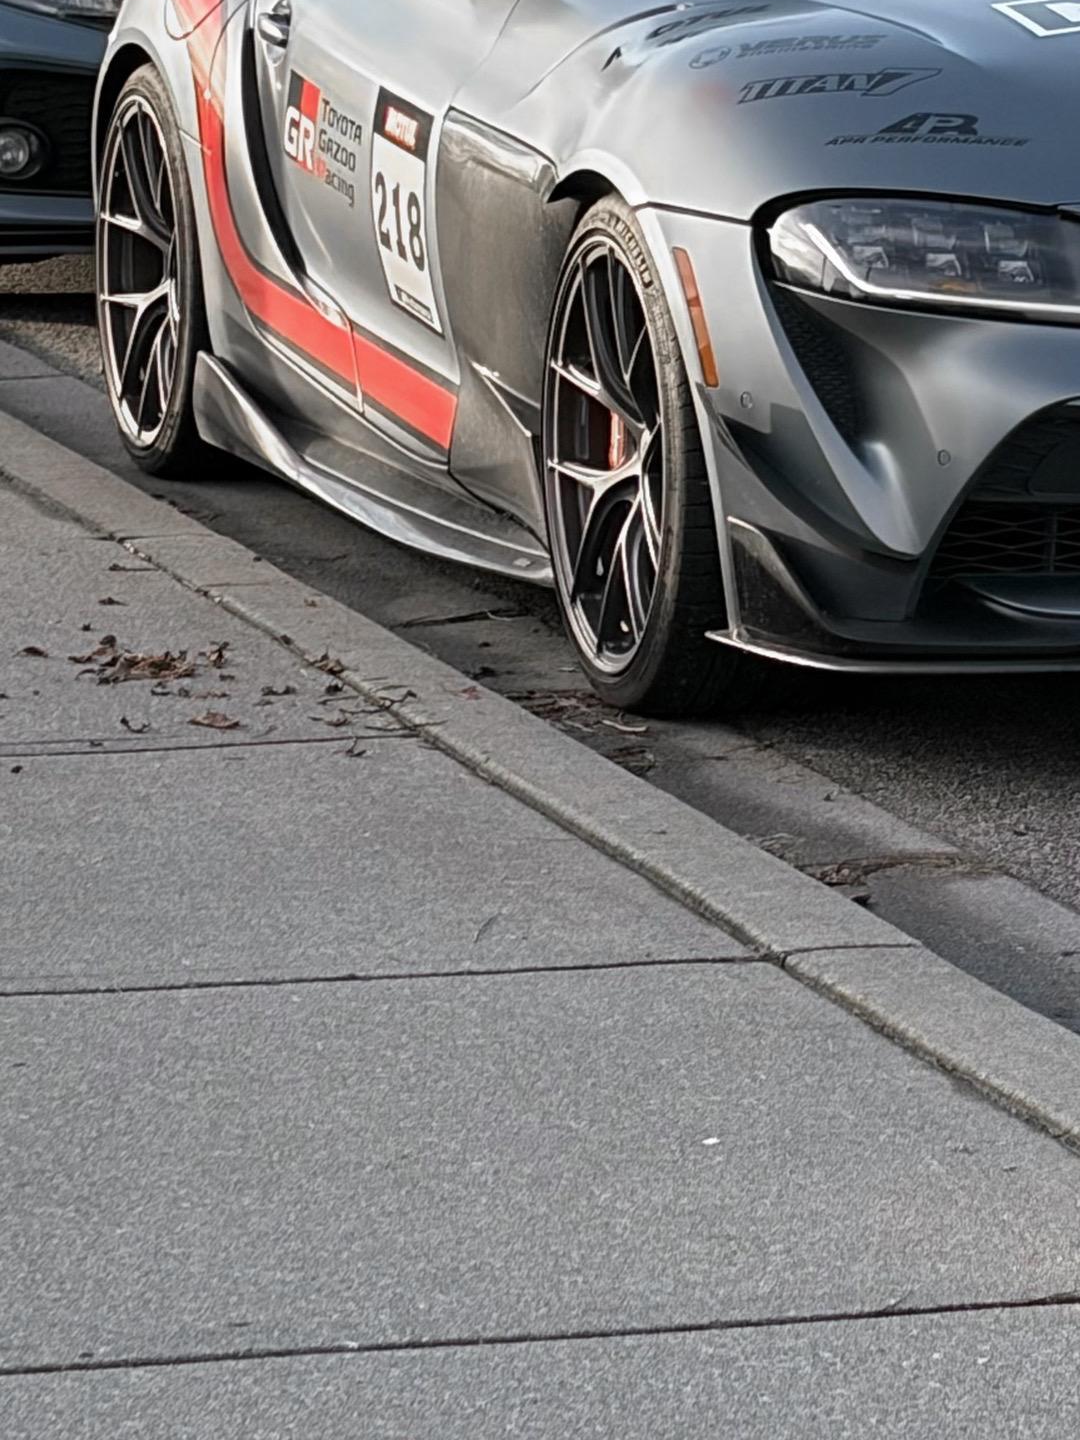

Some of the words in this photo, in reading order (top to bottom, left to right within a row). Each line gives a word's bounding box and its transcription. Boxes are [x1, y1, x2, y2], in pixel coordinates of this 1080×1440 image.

[284, 105, 316, 172] GR
[321, 98, 363, 147] TOYOTA
[314, 157, 355, 208] Racing
[375, 171, 425, 272] 218
